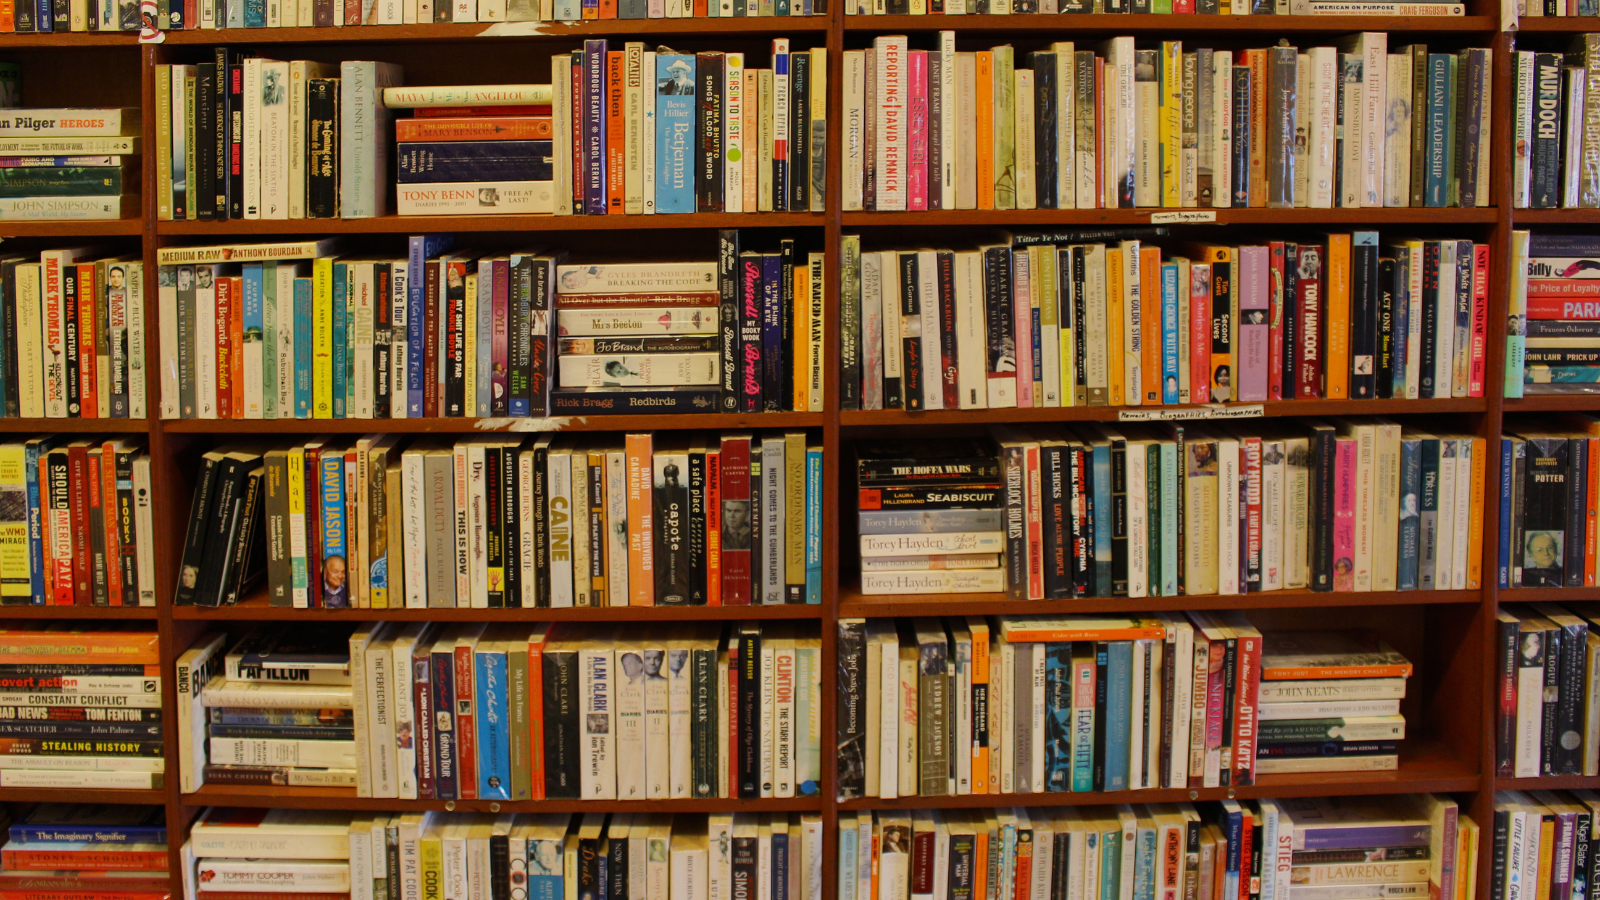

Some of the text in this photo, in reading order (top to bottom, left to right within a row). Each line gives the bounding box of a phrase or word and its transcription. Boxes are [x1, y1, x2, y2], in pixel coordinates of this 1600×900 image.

[1400, 6, 1448, 15] CRAIG FERGUSON
[474, 92, 525, 100] ANGELOU
[591, 52, 599, 123] WONDROUS BEAUTY
[611, 57, 621, 117] back then
[1370, 47, 1380, 122] East Hill Farm
[1435, 59, 1445, 107] GIULIANI
[395, 93, 425, 102] MAYA
[729, 70, 739, 140] SEASON TO TASTE
[1539, 65, 1556, 139] MURDOCH
[15, 118, 104, 129] Pilger HEROES
[355, 95, 363, 142] BENNETT
[664, 109, 688, 117] Hillier
[886, 44, 898, 191] REPORTING DAVID REMNICK
[424, 128, 493, 137] MARY BENSON
[1433, 113, 1444, 178] LEADERSHIP
[591, 130, 599, 189] CAROL BERKIN
[674, 122, 689, 189] Betjeman
[12, 200, 99, 212] JOHN SIMPSON
[403, 190, 475, 201] TONY BENN
[162, 250, 220, 261] MEDIUM RAW
[233, 247, 302, 258] ANTHONY BOURDAIN
[1528, 263, 1552, 277] Billy
[395, 278, 404, 303] Cook's
[811, 259, 822, 342] THE NAKED MAN
[1540, 284, 1559, 293] Price
[1562, 284, 1570, 292] of
[46, 258, 60, 347] MARK THOMAS
[66, 297, 75, 320] FINAL
[218, 283, 228, 345] Dirk Bogarde
[455, 299, 463, 310] MY
[1221, 314, 1230, 344] Second
[1304, 283, 1318, 361] TONY HANCOCK
[68, 323, 76, 362] CENTURY
[455, 349, 462, 358] SO
[556, 398, 613, 408] Rick Bragg
[630, 397, 676, 406] Redbirds
[631, 457, 639, 500] CANNADINE
[641, 467, 650, 489] DAVID
[892, 465, 971, 475] THE HOFFA WARS
[1051, 451, 1062, 499] BILL HICKS
[1248, 442, 1260, 505] ROY HUDD
[1536, 474, 1564, 483] POTTER
[324, 461, 341, 548] DAVID JASON
[522, 495, 530, 522] BURNS
[927, 493, 994, 502] SEABISCUIT
[5, 529, 26, 537] WMD
[55, 465, 72, 588] SHOULD AMERICA PAY?
[550, 497, 569, 562] CAINE
[670, 503, 678, 551] capote
[0, 537, 26, 545] MIRAGE
[641, 515, 651, 571] THE UNDIVIDED
[865, 538, 943, 550] Torey Hayden
[864, 577, 942, 588] Torey Hayden
[179, 667, 189, 693] BANCO
[593, 656, 607, 712] ALAN CLARK
[776, 655, 792, 703] CLINTON
[1195, 666, 1207, 709] JUMBO
[1277, 686, 1339, 697] JOHN KEATS
[29, 695, 128, 705] CONSTANT CONFLICT
[376, 672, 386, 726] PERFECTIONIST
[847, 653, 859, 735] Becoming Steve Jobs
[18, 708, 48, 720] NEWS
[85, 708, 104, 721] TOM
[107, 709, 141, 721] FENTON
[42, 742, 140, 752] STEALING HISTORY
[780, 708, 789, 769] THE STARR REPORT
[1238, 706, 1253, 770] OTTO KATZ
[36, 832, 126, 842] The Imaginary Signifier
[1278, 836, 1291, 872] STIEG
[1561, 821, 1573, 883] FRANK SKINNER
[257, 872, 293, 880] COOPER
[1327, 865, 1399, 879] LAWRENCE
